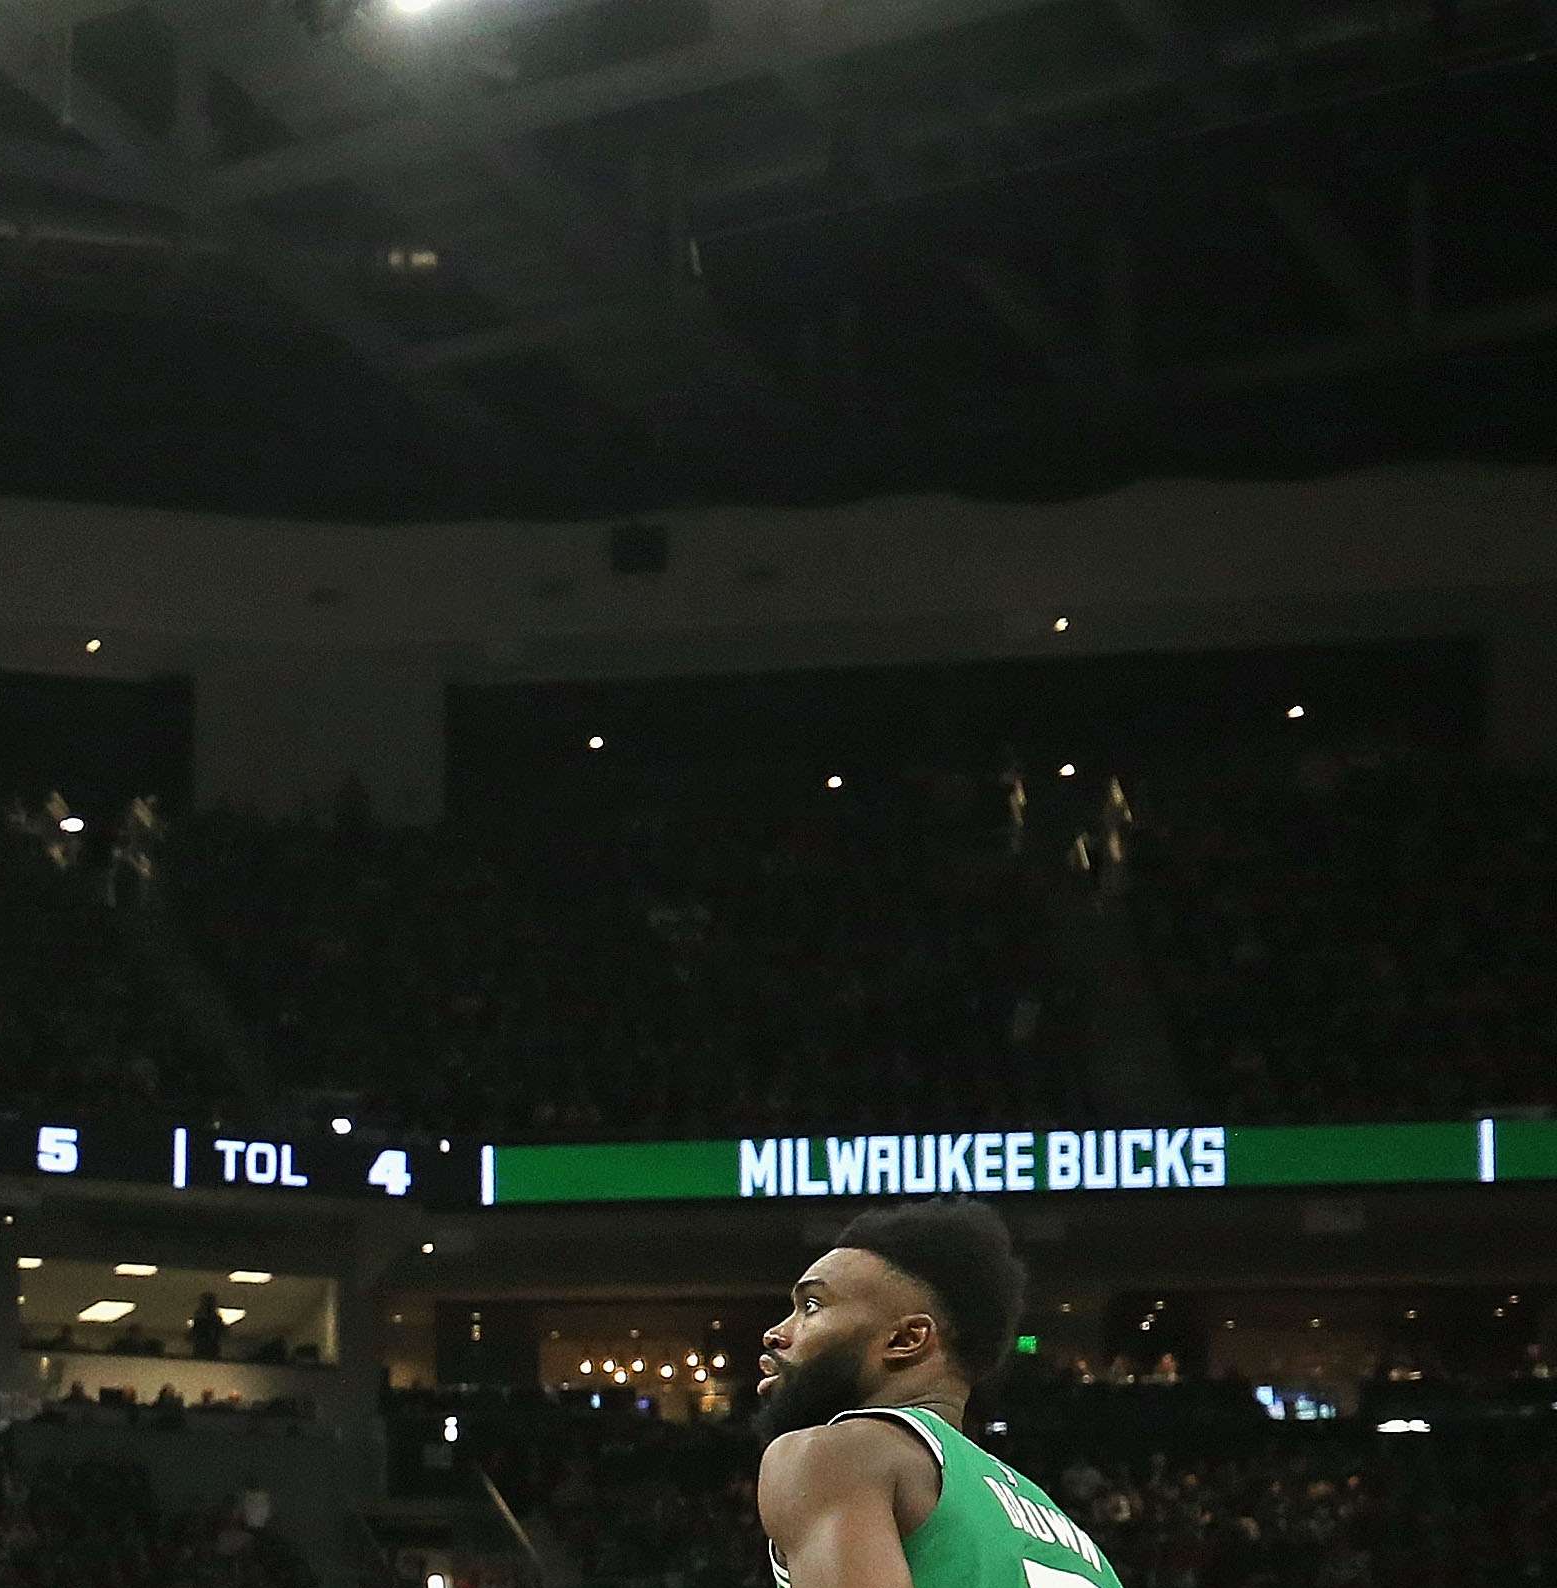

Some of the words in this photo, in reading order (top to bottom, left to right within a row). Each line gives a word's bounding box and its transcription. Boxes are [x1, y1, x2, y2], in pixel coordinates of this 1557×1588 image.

[36, 1126, 79, 1173] 5
[214, 1140, 308, 1188] TOL
[368, 1150, 411, 1195] 4
[738, 1131, 1036, 1197] MILWAUKEE
[1046, 1126, 1227, 1191] BUCKS
